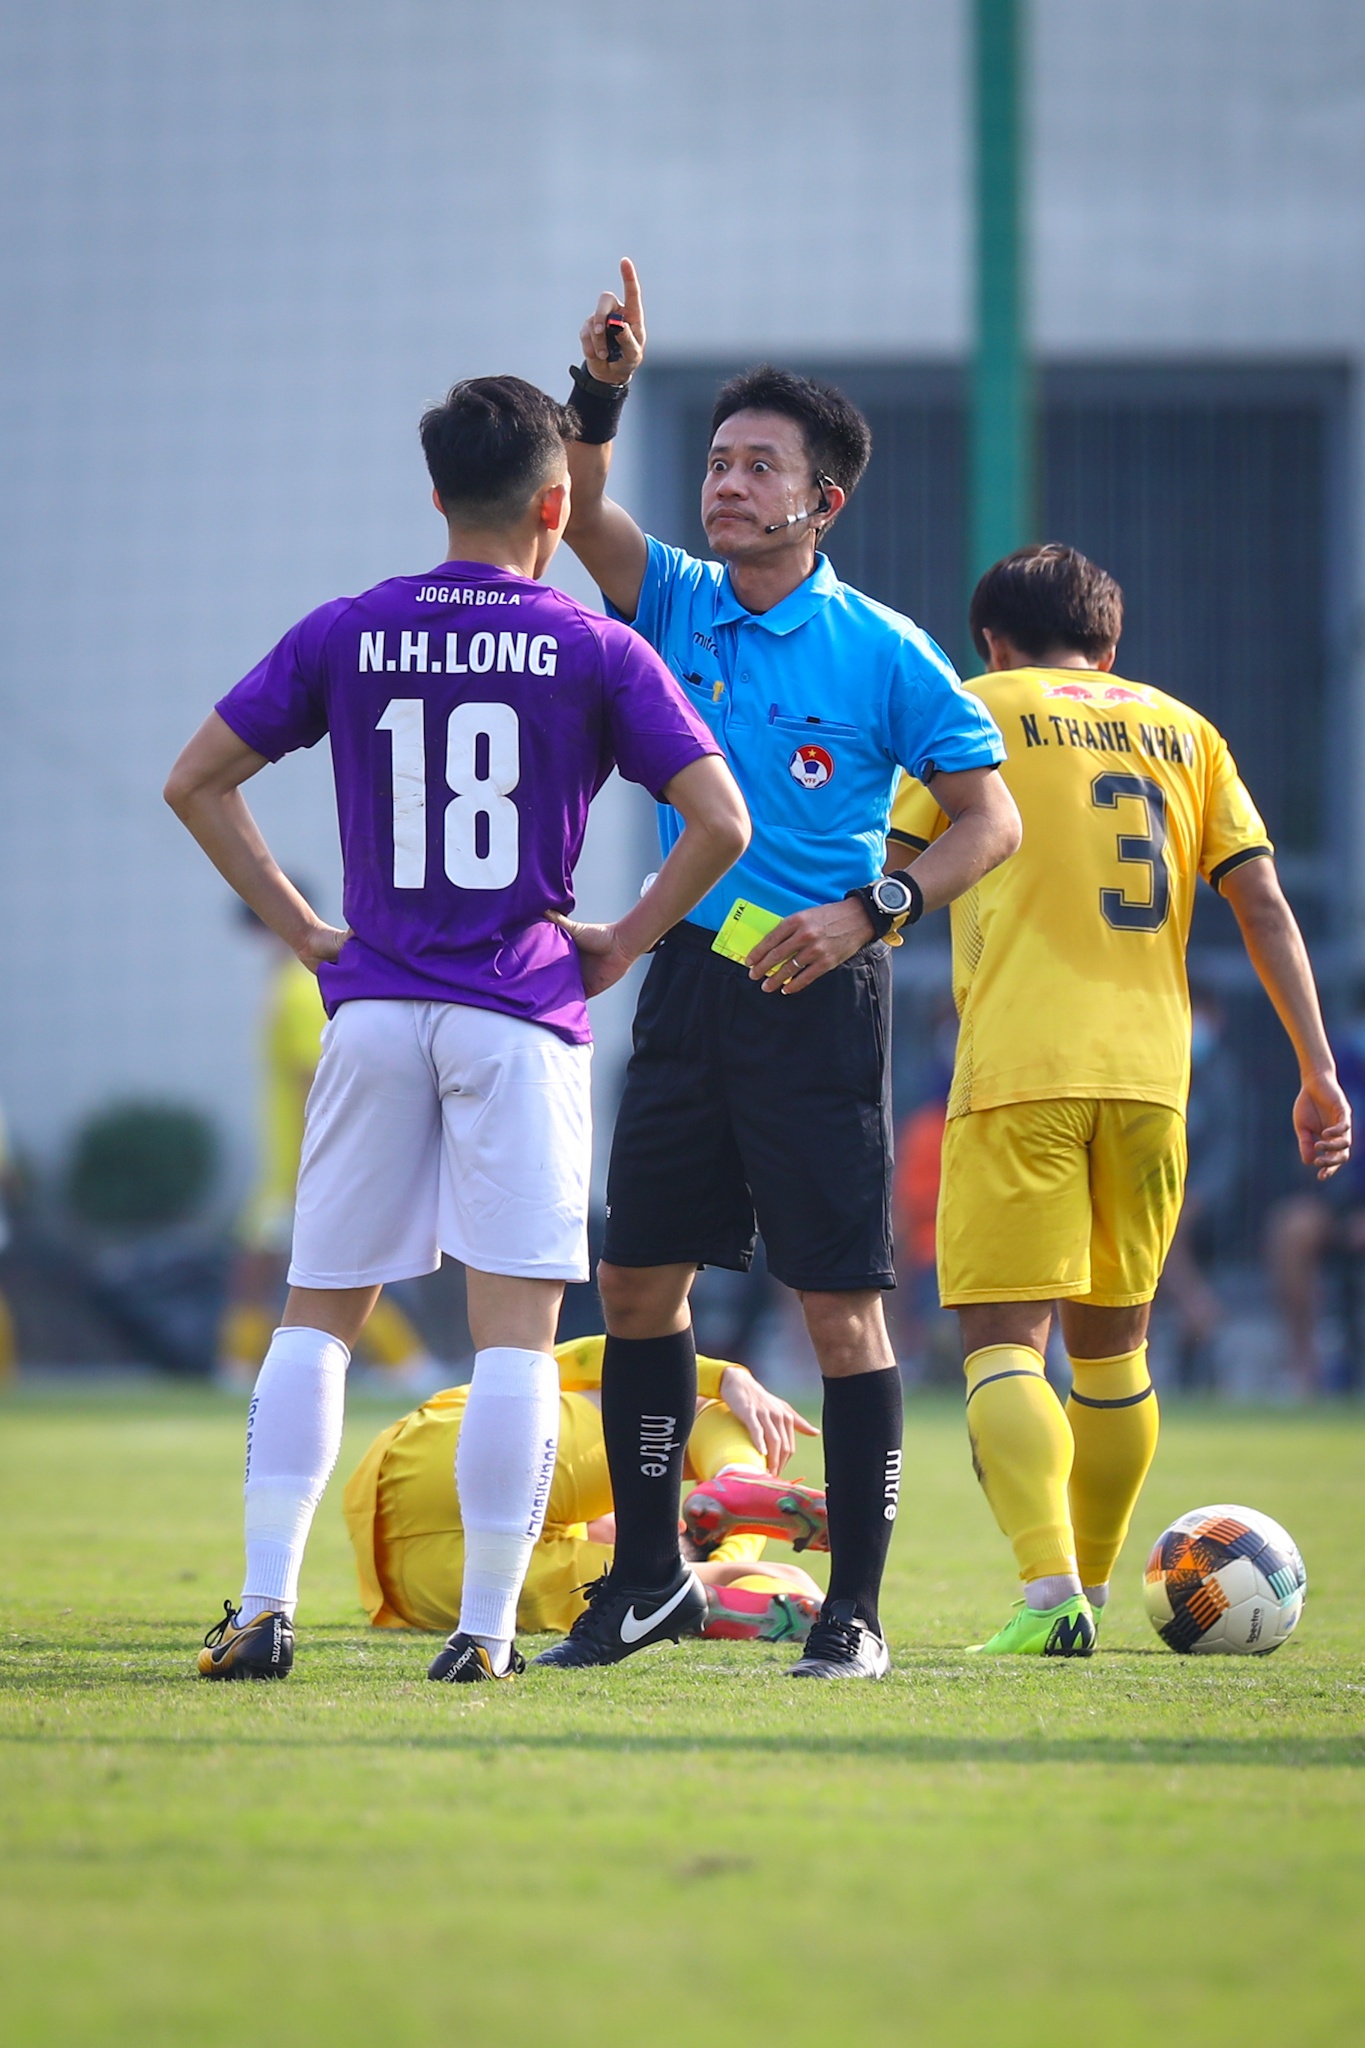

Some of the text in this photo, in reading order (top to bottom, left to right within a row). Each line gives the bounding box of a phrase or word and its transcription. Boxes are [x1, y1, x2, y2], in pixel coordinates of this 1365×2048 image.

[415, 586, 521, 606] JOGARBOLA
[358, 630, 559, 677] N.H.LONG
[374, 698, 520, 890] 18
[1091, 771, 1170, 933] 3
[733, 905, 745, 921] FIFA
[640, 1414, 680, 1478] mitre
[884, 1449, 902, 1522] mitre
